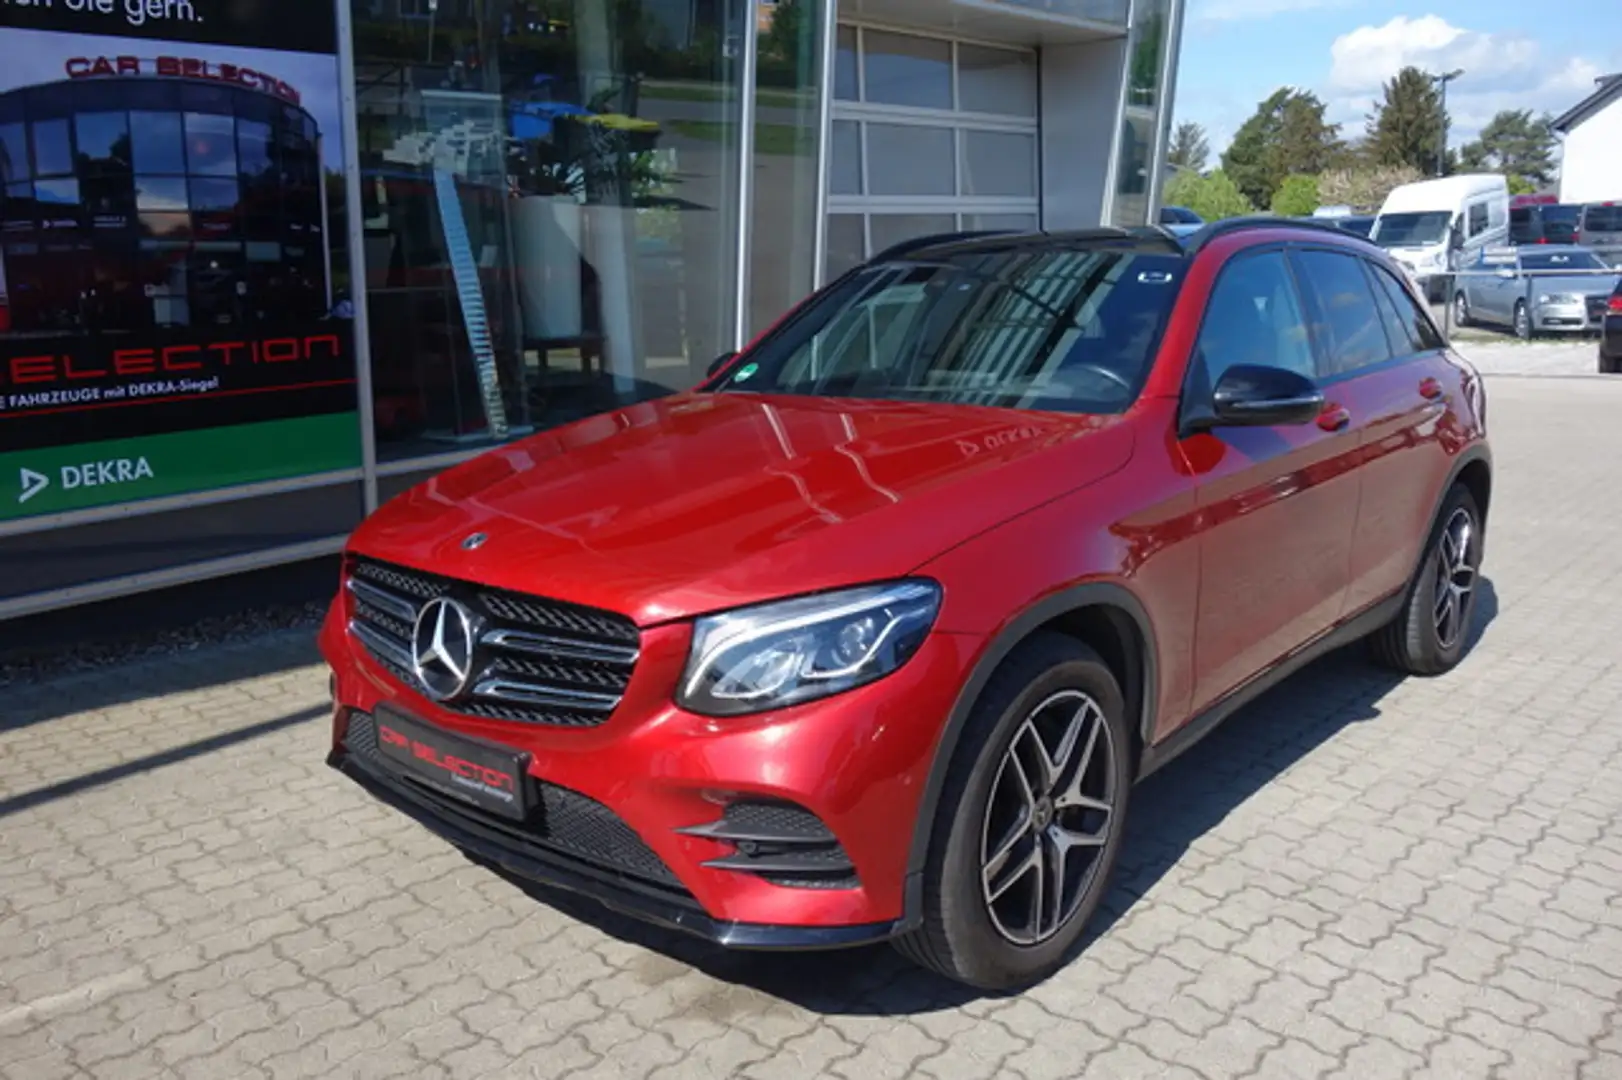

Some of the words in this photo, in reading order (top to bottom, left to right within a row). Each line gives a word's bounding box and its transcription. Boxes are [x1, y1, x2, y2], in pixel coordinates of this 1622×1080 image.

[65, 55, 141, 78] CAR
[0, 335, 340, 387] ELECTION
[9, 387, 100, 408] FAHRZEUGE
[104, 385, 126, 399] mit
[129, 375, 220, 396] DEKRA-Siegel
[60, 456, 154, 489] DEKRA
